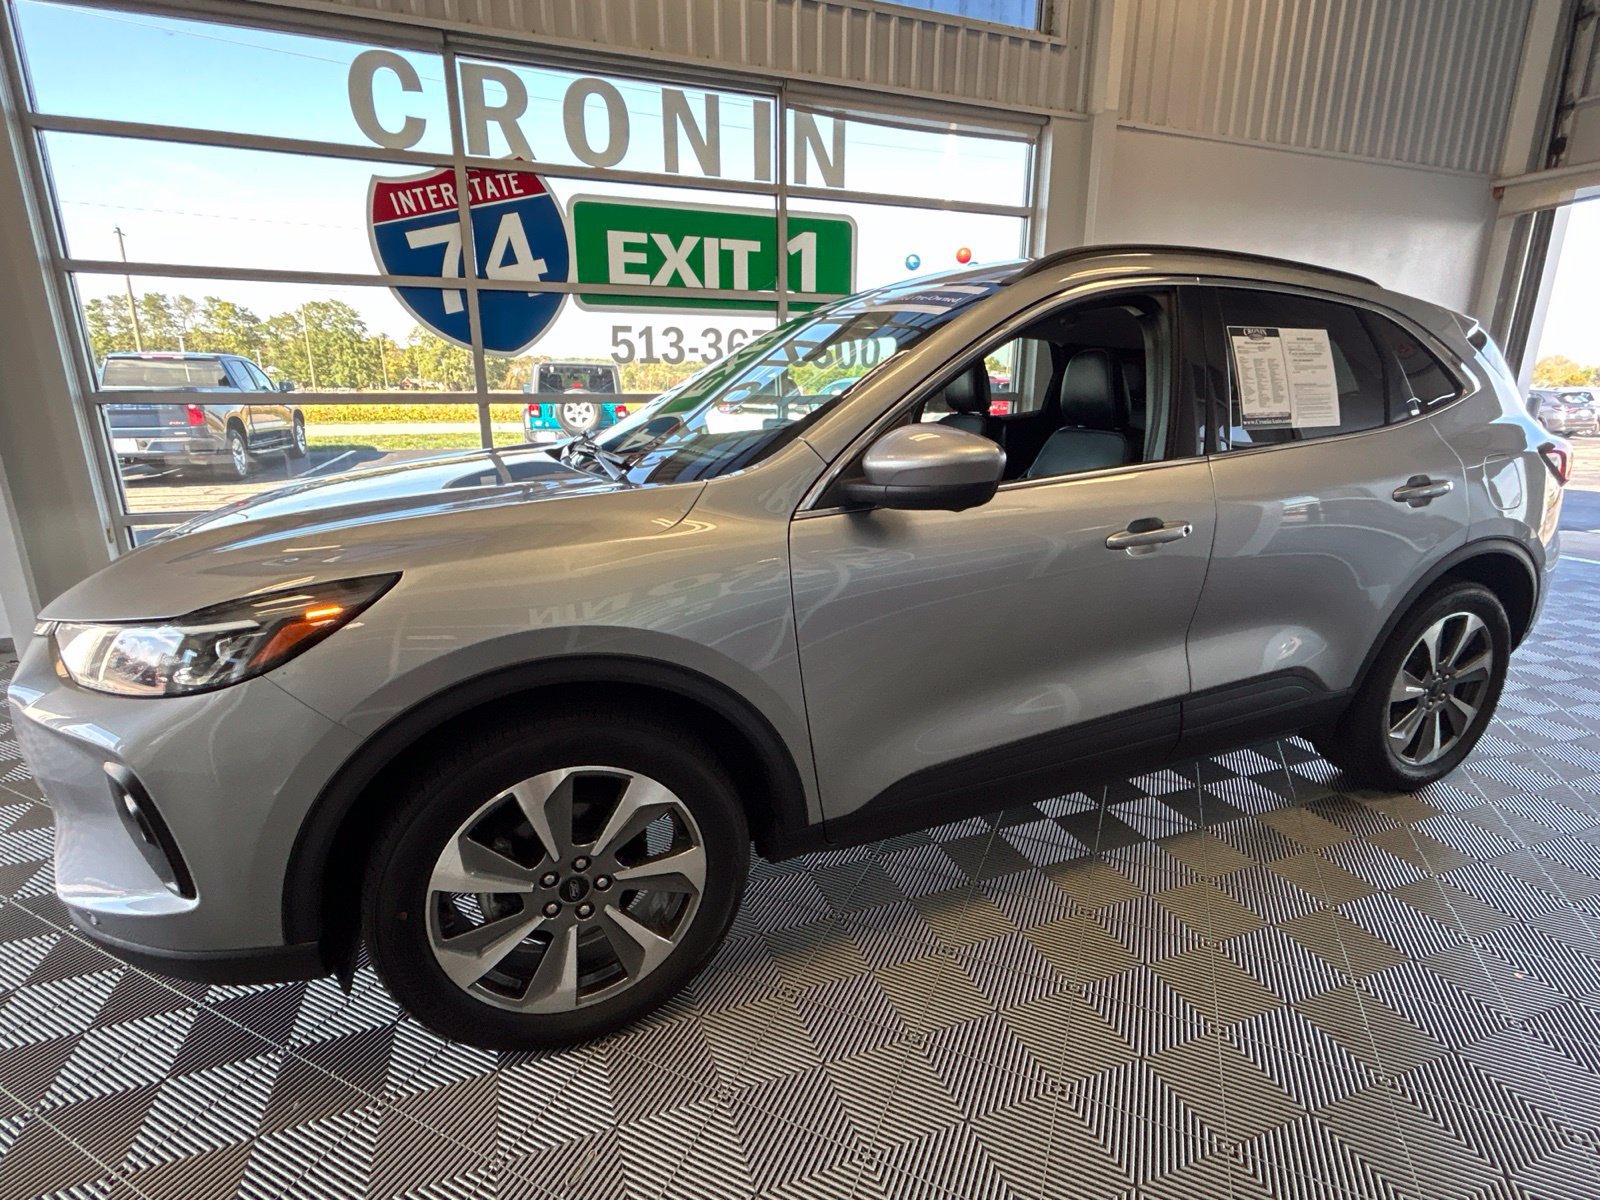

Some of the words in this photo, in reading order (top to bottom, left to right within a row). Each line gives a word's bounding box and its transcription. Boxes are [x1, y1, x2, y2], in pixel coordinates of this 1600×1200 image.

[347, 50, 846, 188] CRONIN
[389, 173, 524, 216] INTERTATE
[405, 212, 548, 315] 74
[607, 230, 761, 291] EXIT
[787, 231, 817, 293] 1
